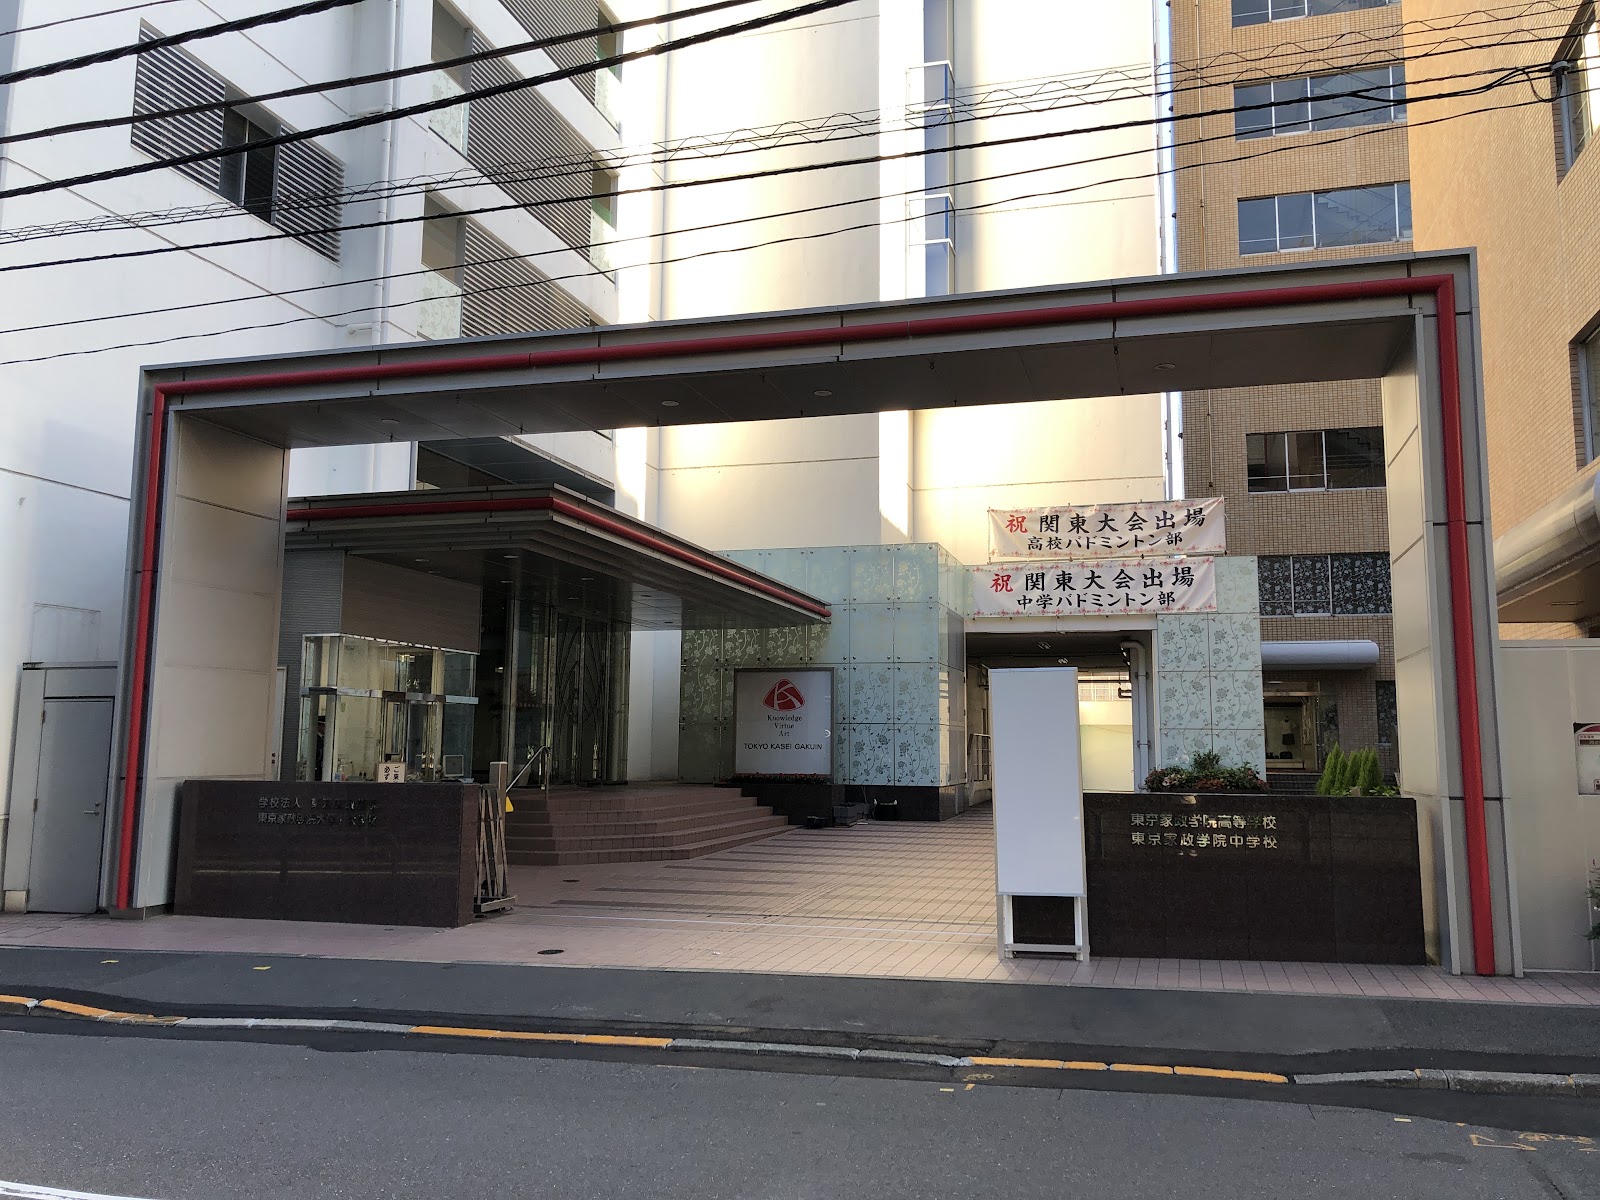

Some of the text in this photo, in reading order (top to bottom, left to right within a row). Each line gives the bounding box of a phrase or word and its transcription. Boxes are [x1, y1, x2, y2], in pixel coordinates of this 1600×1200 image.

[1027, 531, 1183, 551] 高校バドミントン部
[1017, 591, 1176, 610] 中学バドミントン部
[767, 714, 802, 722] Knowledge
[1130, 812, 1277, 830] 東京家政学院高等学校
[1131, 832, 1278, 850] 東京家政学院中学校
